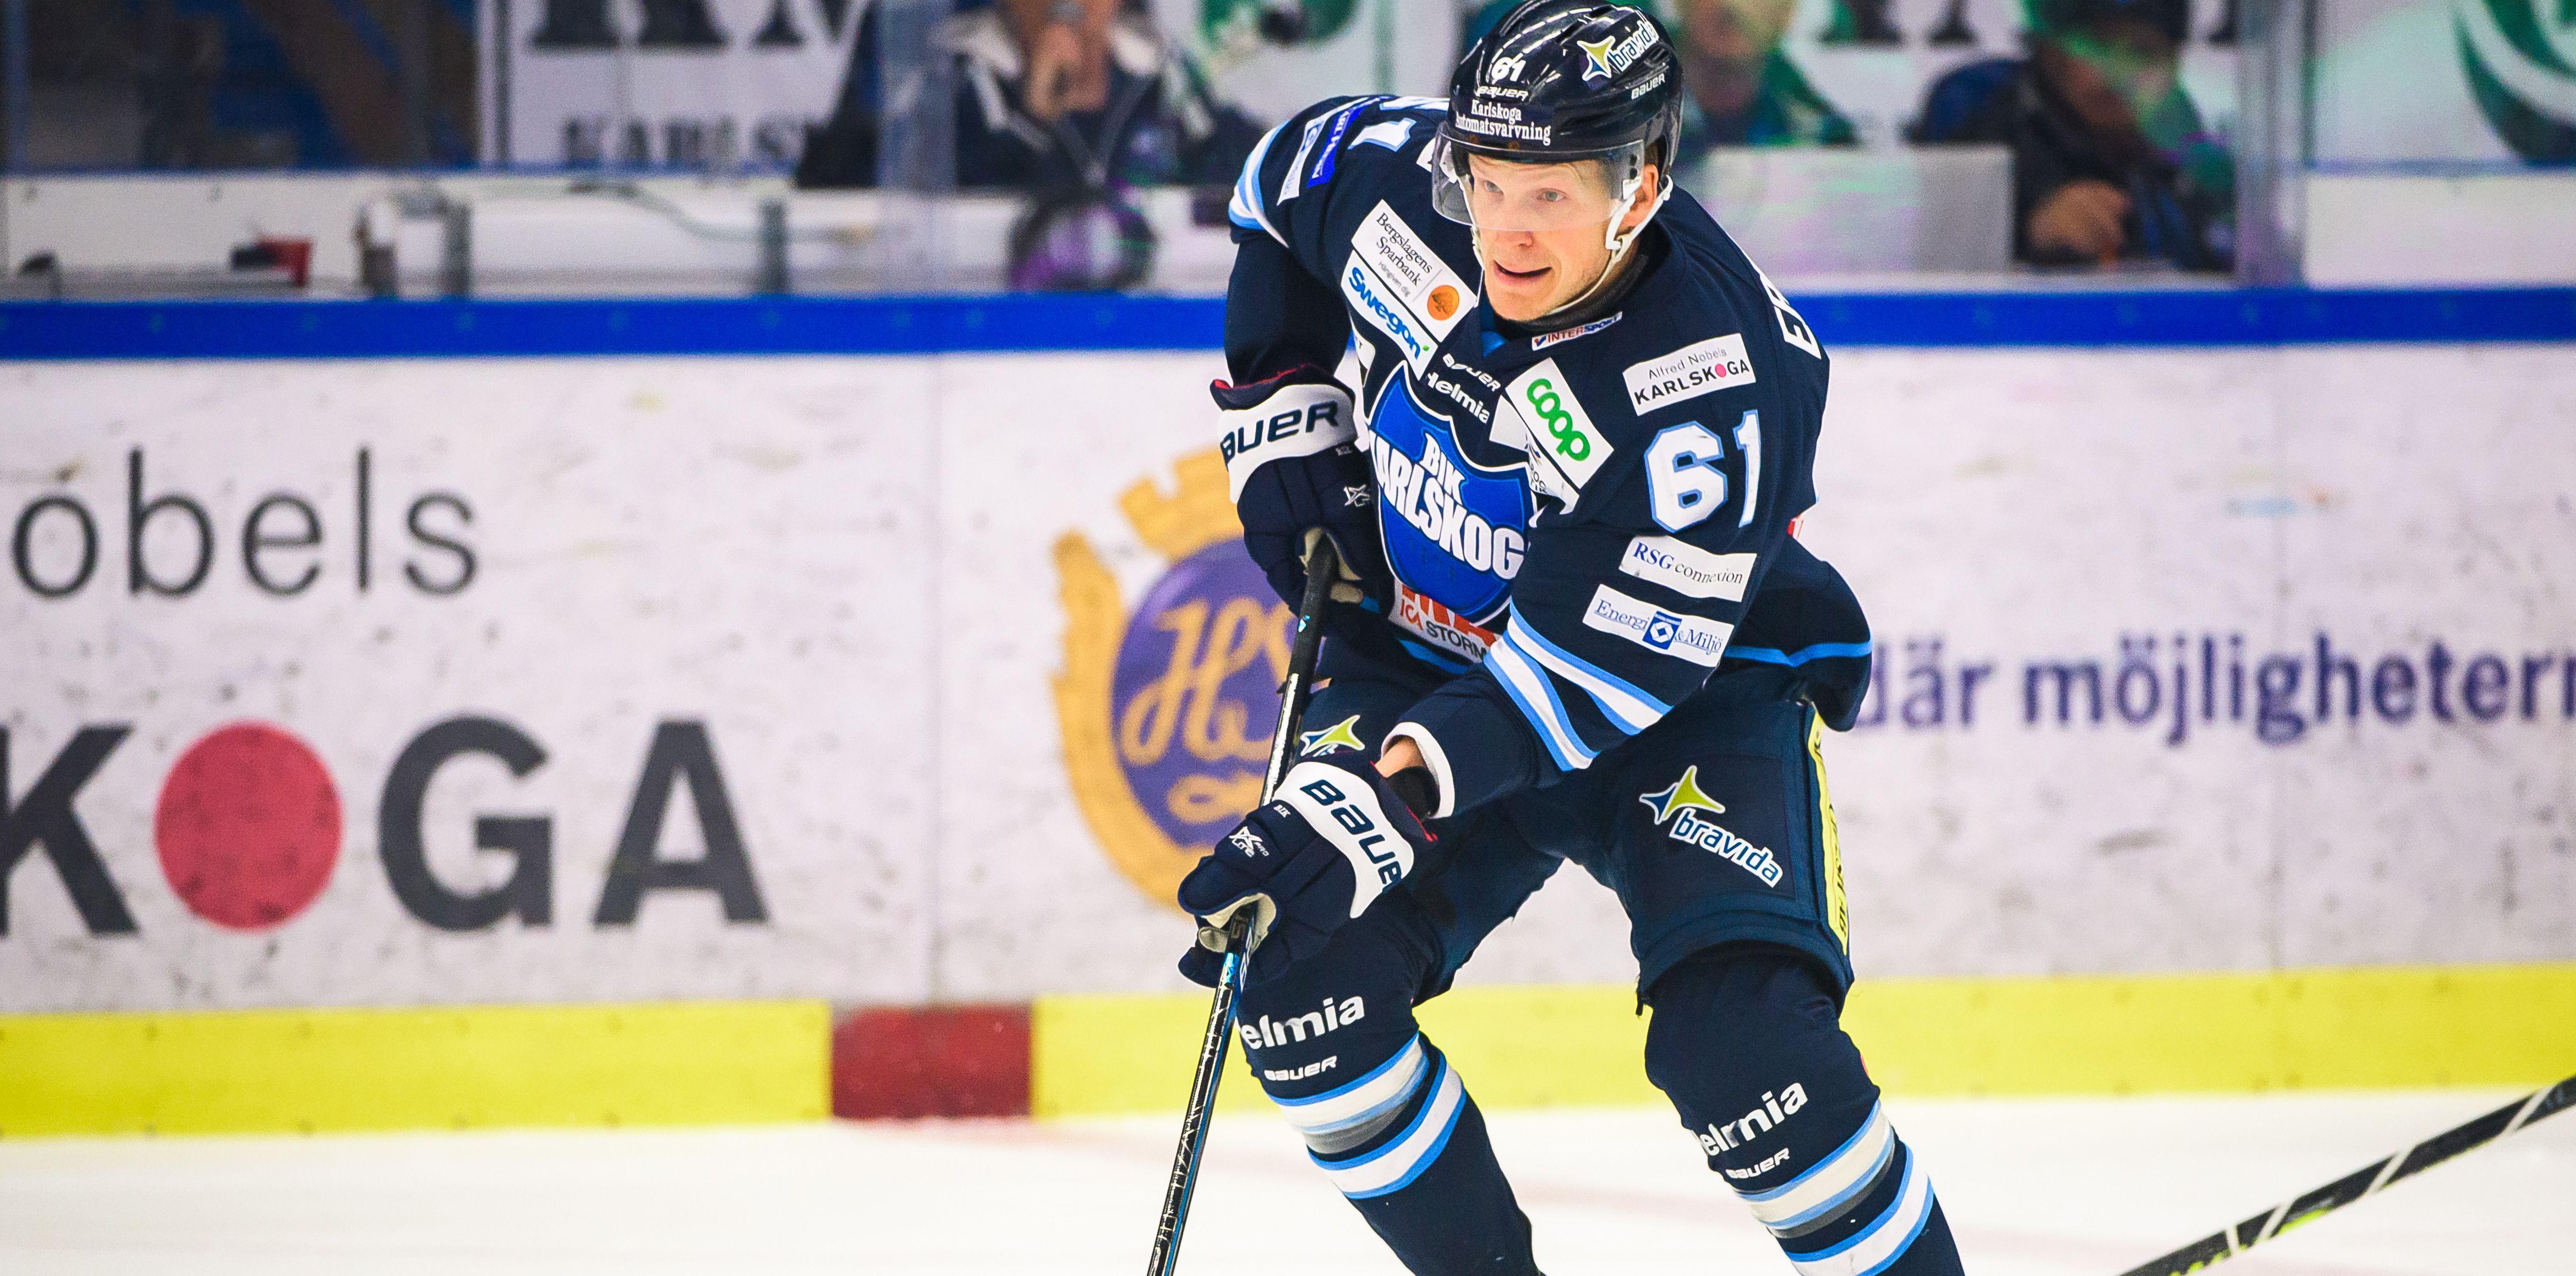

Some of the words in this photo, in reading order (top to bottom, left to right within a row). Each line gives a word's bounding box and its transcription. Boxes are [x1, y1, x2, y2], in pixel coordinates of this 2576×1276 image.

[1491, 57, 1526, 82] 61
[1471, 99, 1522, 124] Karlskoga
[1376, 212, 1433, 274] Bergslagens
[1376, 236, 1422, 286] Sparbank
[1348, 267, 1421, 361] Swegon
[1649, 361, 1685, 379] Alfred
[1687, 347, 1727, 366] Nobels
[1527, 378, 1591, 462] coop
[1419, 433, 1467, 505] BIK
[1643, 409, 1760, 534] 61
[1633, 542, 1675, 570] RSG
[1674, 562, 1743, 584] connexion
[1399, 599, 1424, 631] ICA
[1596, 599, 1650, 630] Energi
[1684, 629, 1723, 655] Miljö
[1299, 779, 1402, 894] BAUE
[1672, 809, 1781, 885] bravida
[1264, 1055, 1337, 1081] BAUER
[1691, 1082, 1808, 1156] elmia
